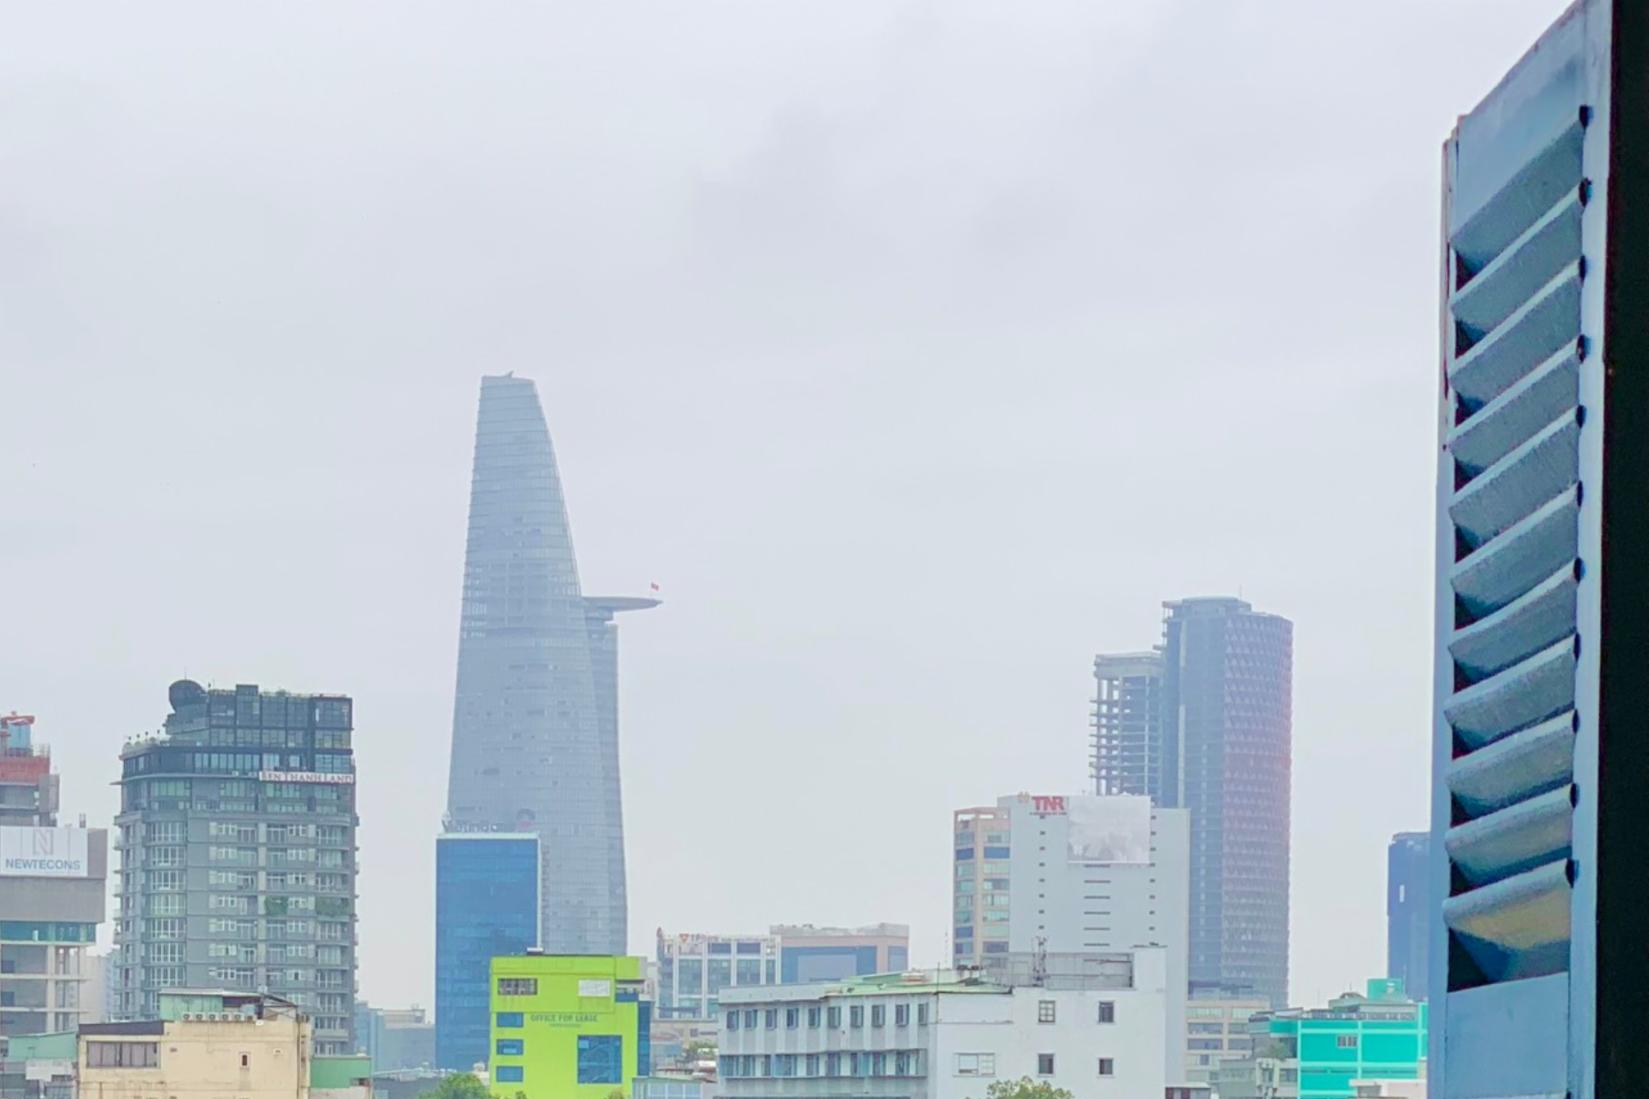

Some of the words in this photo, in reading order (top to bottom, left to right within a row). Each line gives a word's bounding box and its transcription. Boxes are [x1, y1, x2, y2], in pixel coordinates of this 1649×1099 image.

[1031, 795, 1065, 811] TNR
[5, 858, 81, 870] NEWTECONS
[530, 1014, 558, 1022] OFFICE
[558, 1014, 574, 1022] FOR
